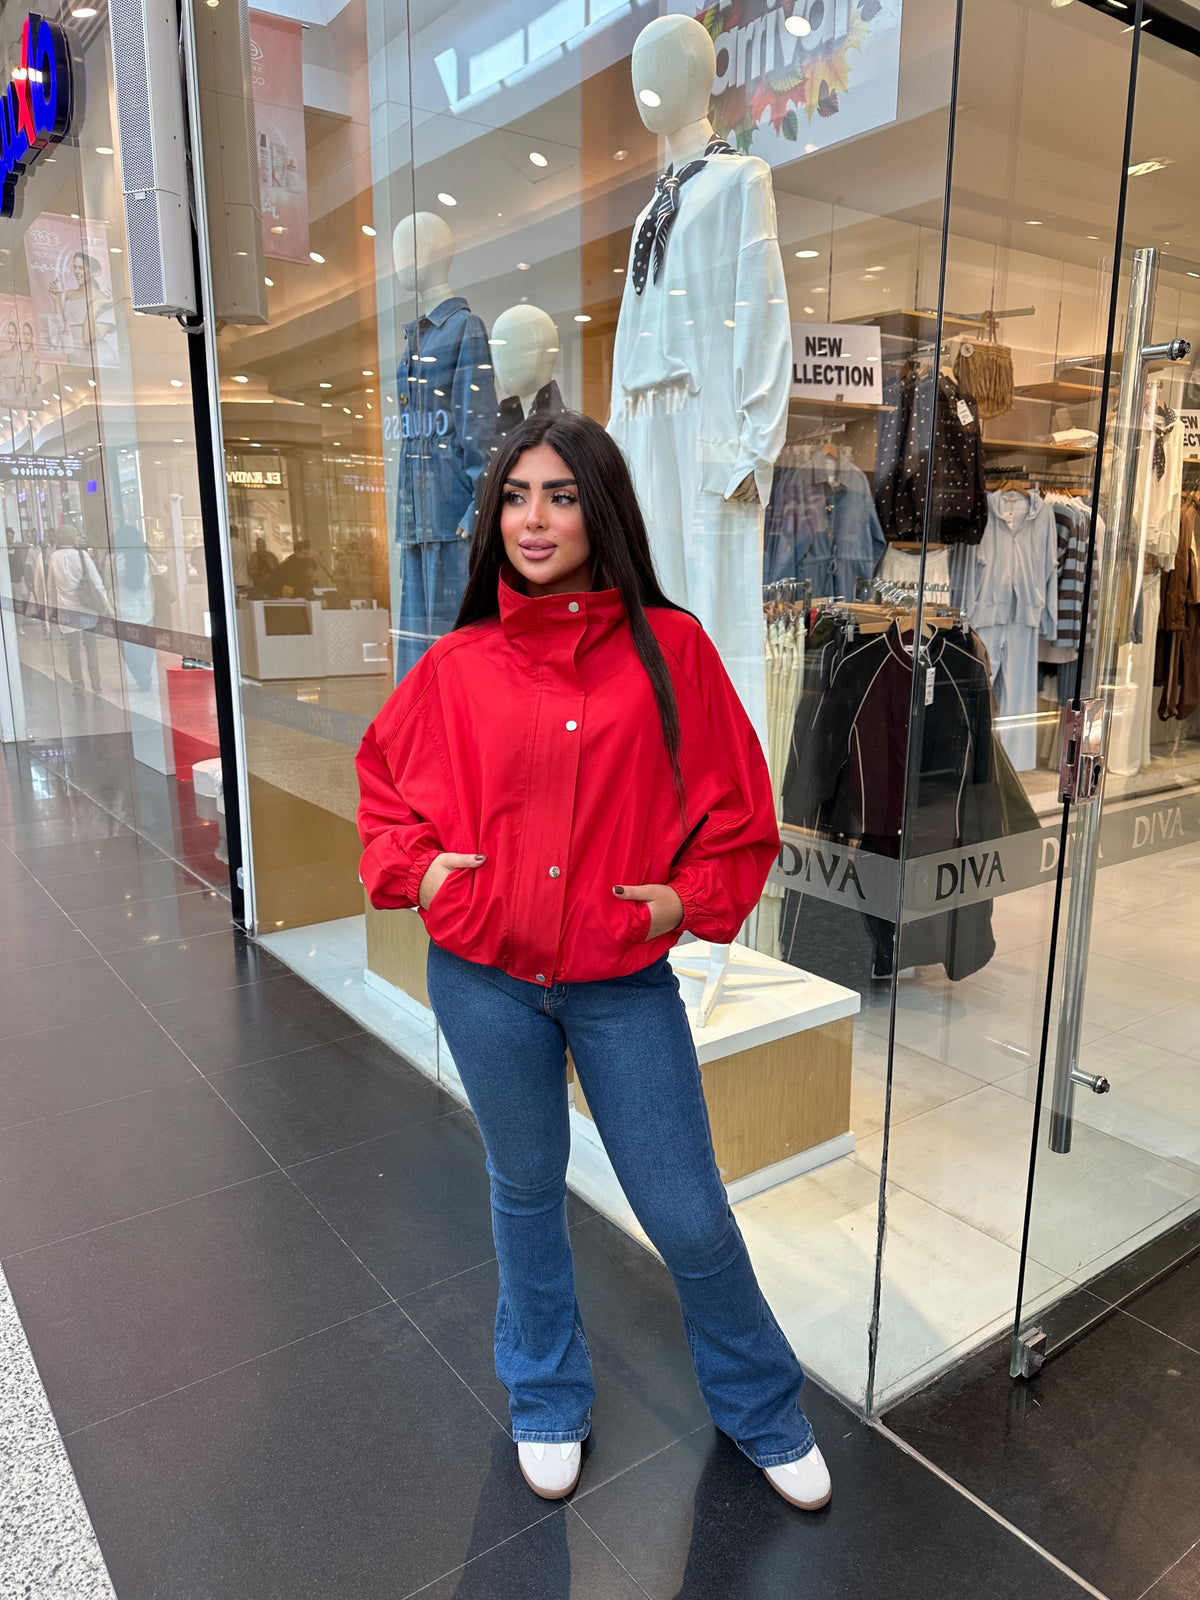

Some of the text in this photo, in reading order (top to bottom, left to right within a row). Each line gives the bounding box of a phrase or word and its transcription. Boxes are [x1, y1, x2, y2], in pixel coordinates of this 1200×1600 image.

[804, 336, 843, 358] NEW
[792, 363, 874, 387] LLECTION
[1180, 415, 1199, 430] EW
[1131, 806, 1185, 849] DIVA
[776, 840, 867, 901] DIVA
[934, 850, 1006, 901] DIVA
